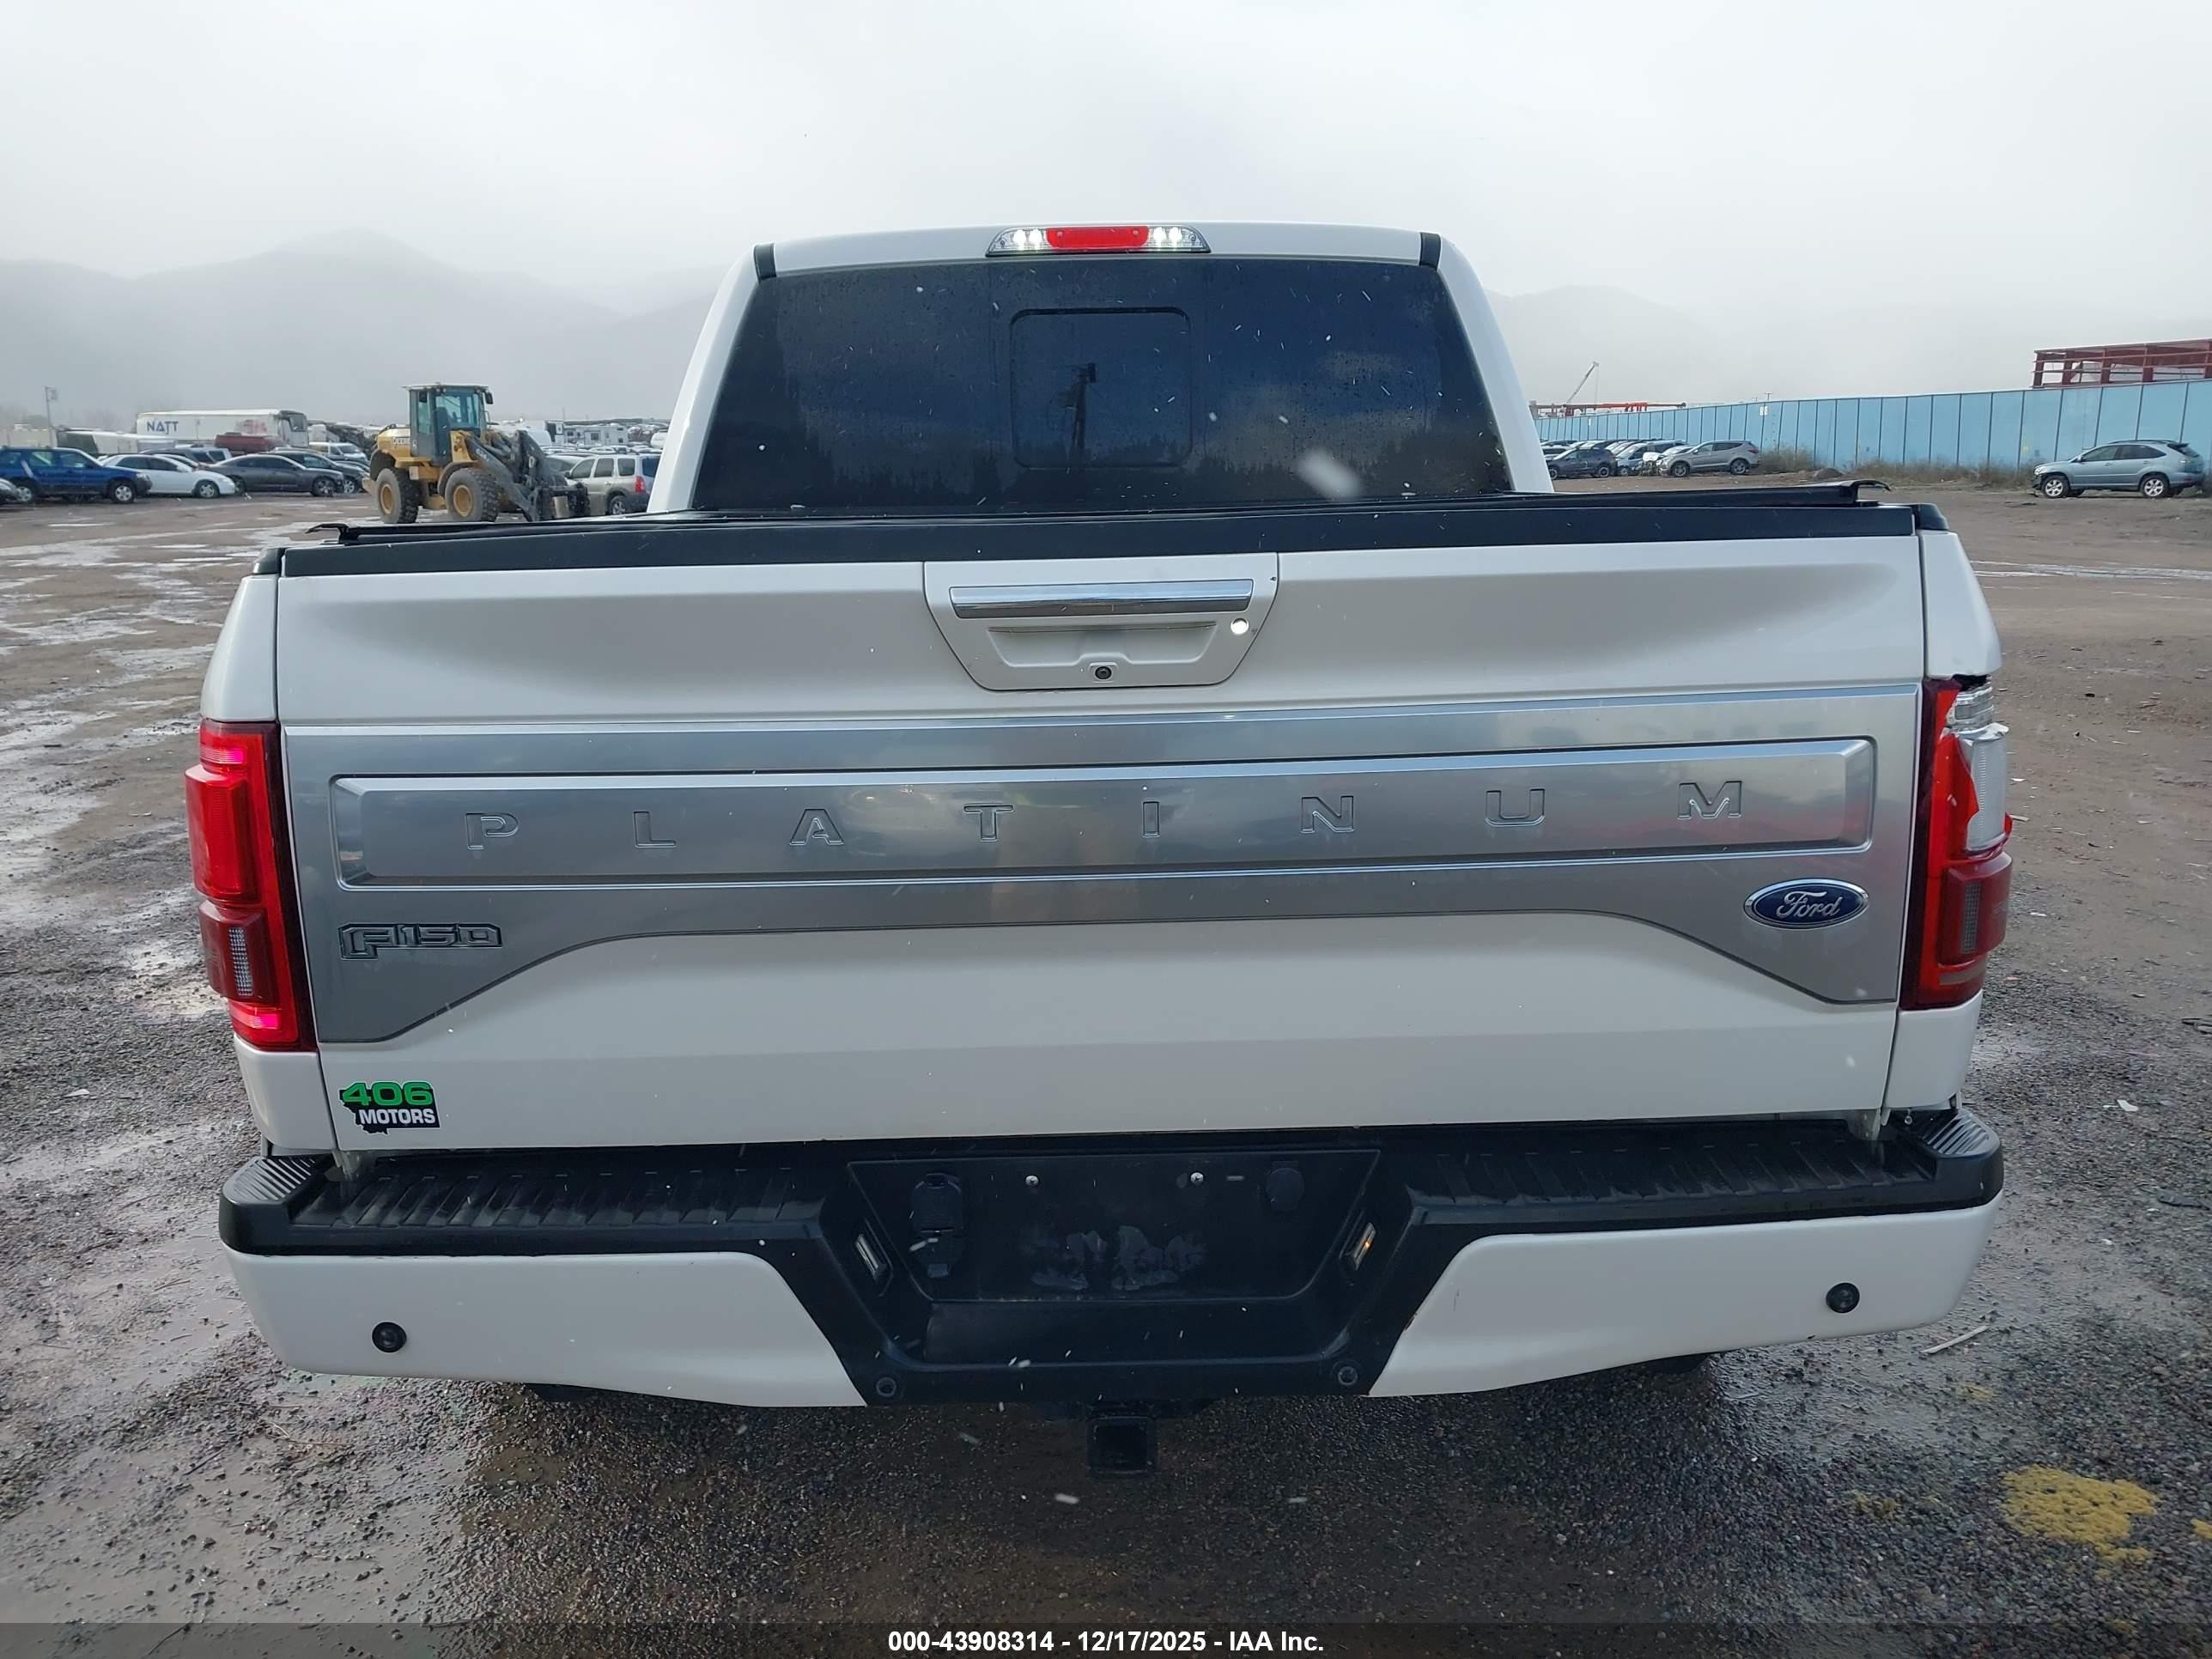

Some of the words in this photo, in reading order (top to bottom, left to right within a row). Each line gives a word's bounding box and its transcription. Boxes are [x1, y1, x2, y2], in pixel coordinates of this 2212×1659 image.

[146, 421, 179, 434] NATT
[465, 779, 1743, 851] PLATINUM
[1776, 890, 1844, 918] Ford
[342, 1081, 433, 1106] 406
[358, 1108, 436, 1125] MOTORS
